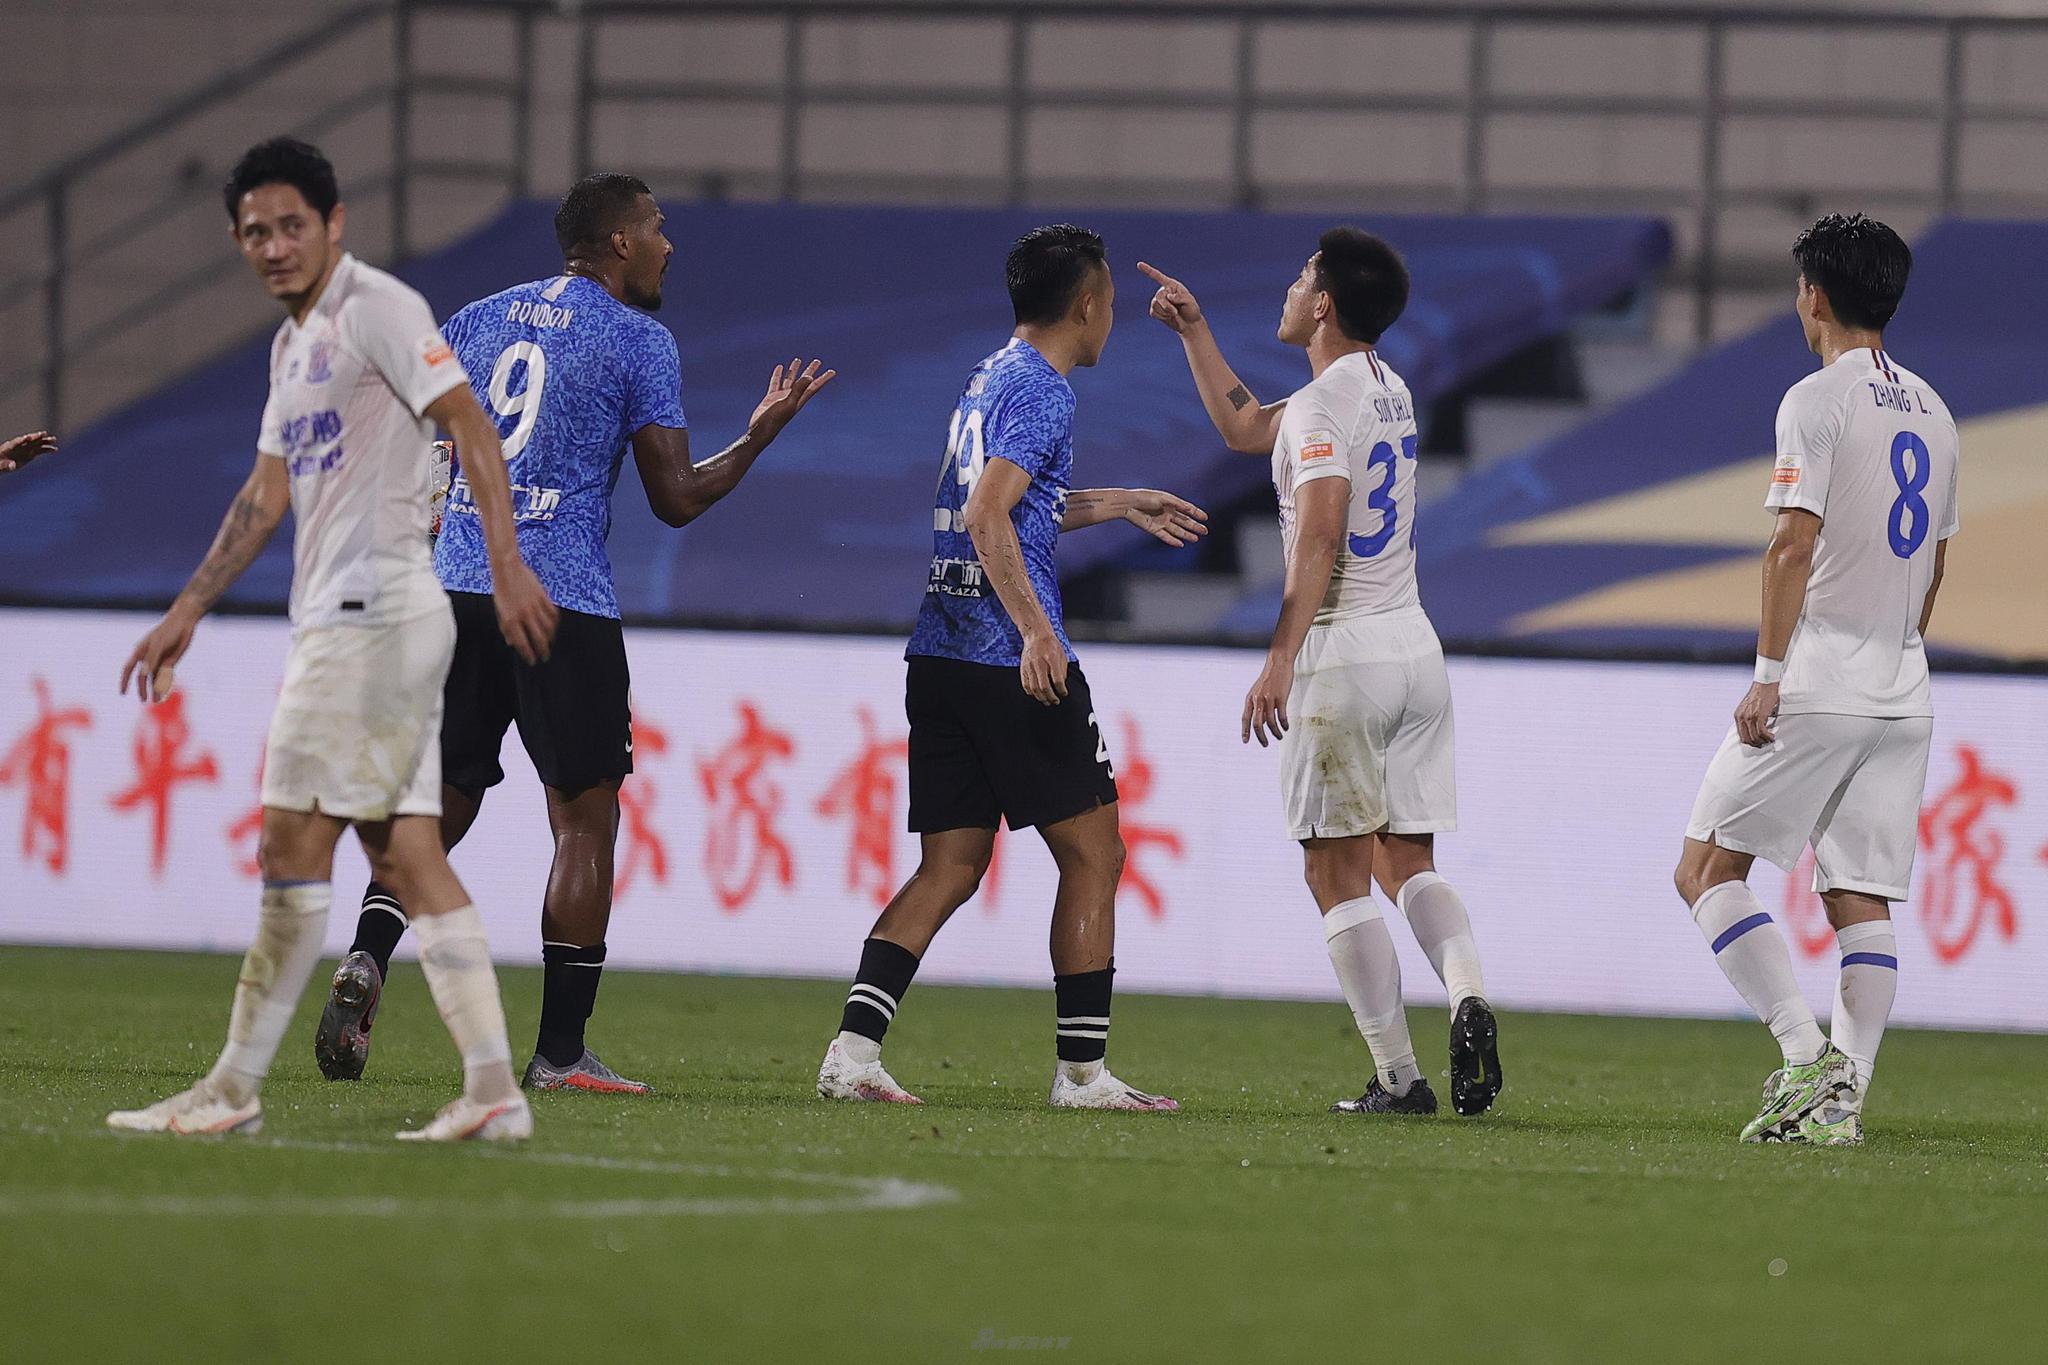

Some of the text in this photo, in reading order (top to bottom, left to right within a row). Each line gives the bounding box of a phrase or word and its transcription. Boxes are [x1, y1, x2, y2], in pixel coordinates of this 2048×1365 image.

[507, 301, 574, 329] RONDON
[489, 341, 545, 461] 9
[1374, 397, 1393, 423] SUN
[1869, 383, 1932, 415] ZHANG L.
[1887, 431, 1930, 559] 8
[512, 510, 554, 522] LAZA
[941, 585, 981, 597] PLAZA
